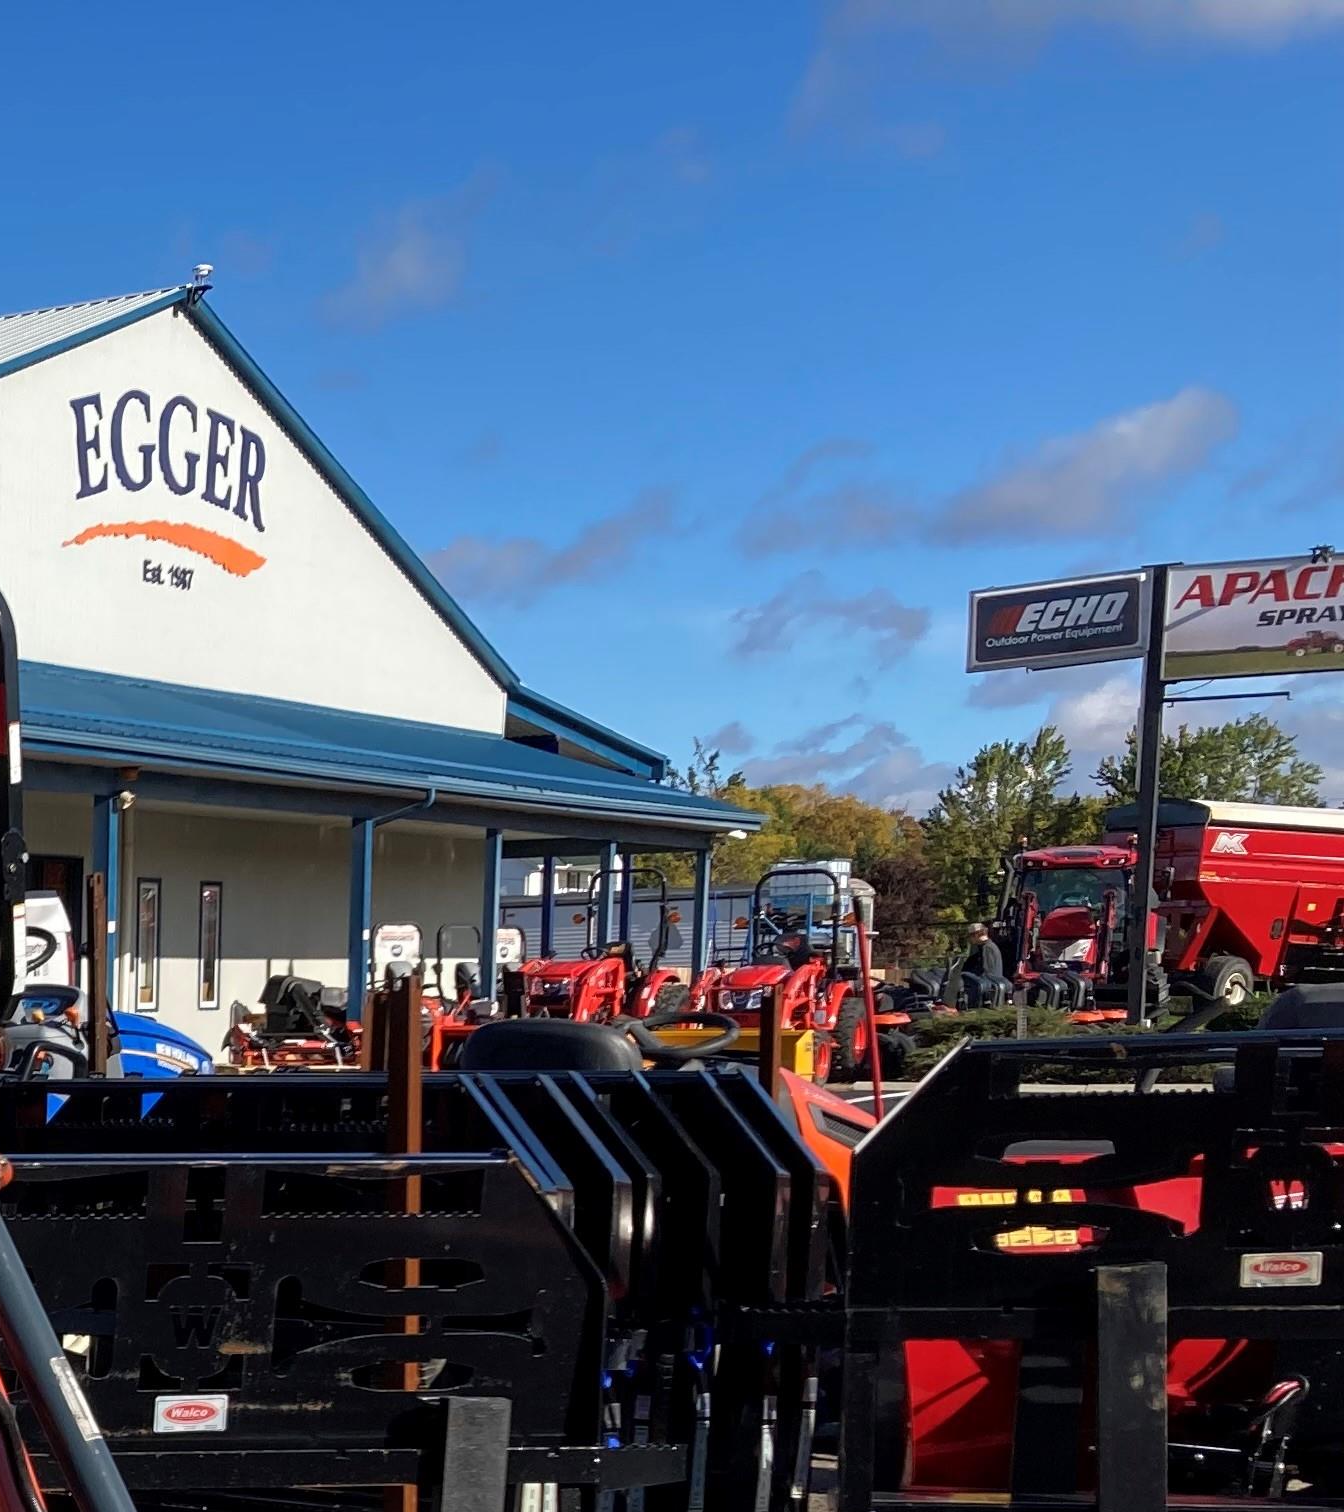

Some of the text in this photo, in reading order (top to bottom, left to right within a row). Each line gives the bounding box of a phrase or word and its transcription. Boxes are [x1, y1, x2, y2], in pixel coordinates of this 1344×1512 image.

[69, 389, 266, 532] EGGER
[142, 559, 165, 585] Est.
[1015, 591, 1130, 633] ECHO
[985, 622, 1124, 648] Outdoor Power Equipment
[172, 1407, 209, 1418] Walco
